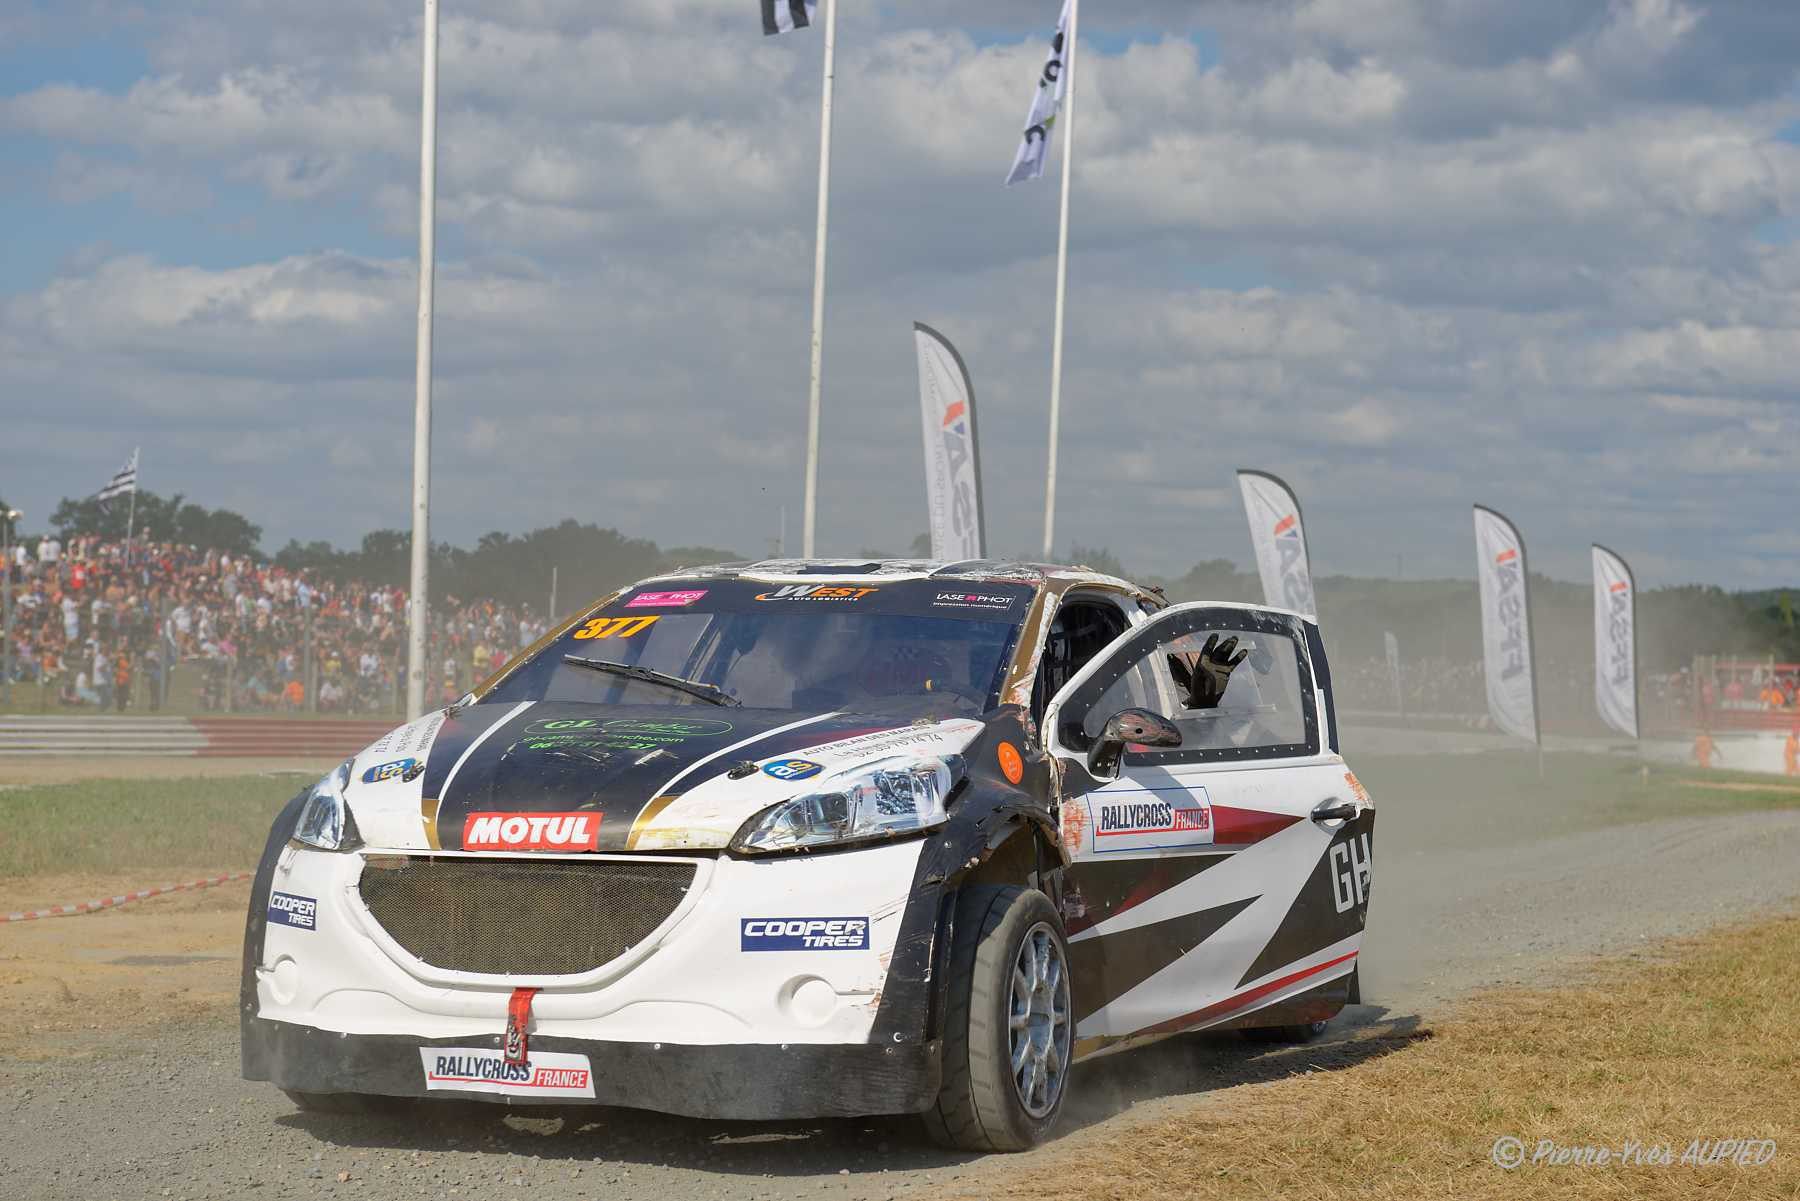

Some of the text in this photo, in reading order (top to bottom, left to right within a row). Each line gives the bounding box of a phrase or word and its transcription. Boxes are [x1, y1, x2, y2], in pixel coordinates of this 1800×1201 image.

[774, 584, 880, 598] WEST
[573, 615, 661, 639] 377
[1101, 803, 1209, 831] RALLYCROSS FRANCE
[467, 816, 591, 845] MOTUL
[271, 894, 315, 916] COOPER
[288, 912, 314, 927] TIRES
[744, 920, 867, 937] COOPER
[802, 935, 864, 948] TIRES
[435, 1055, 586, 1088] RALLYCROSS FRANCE
